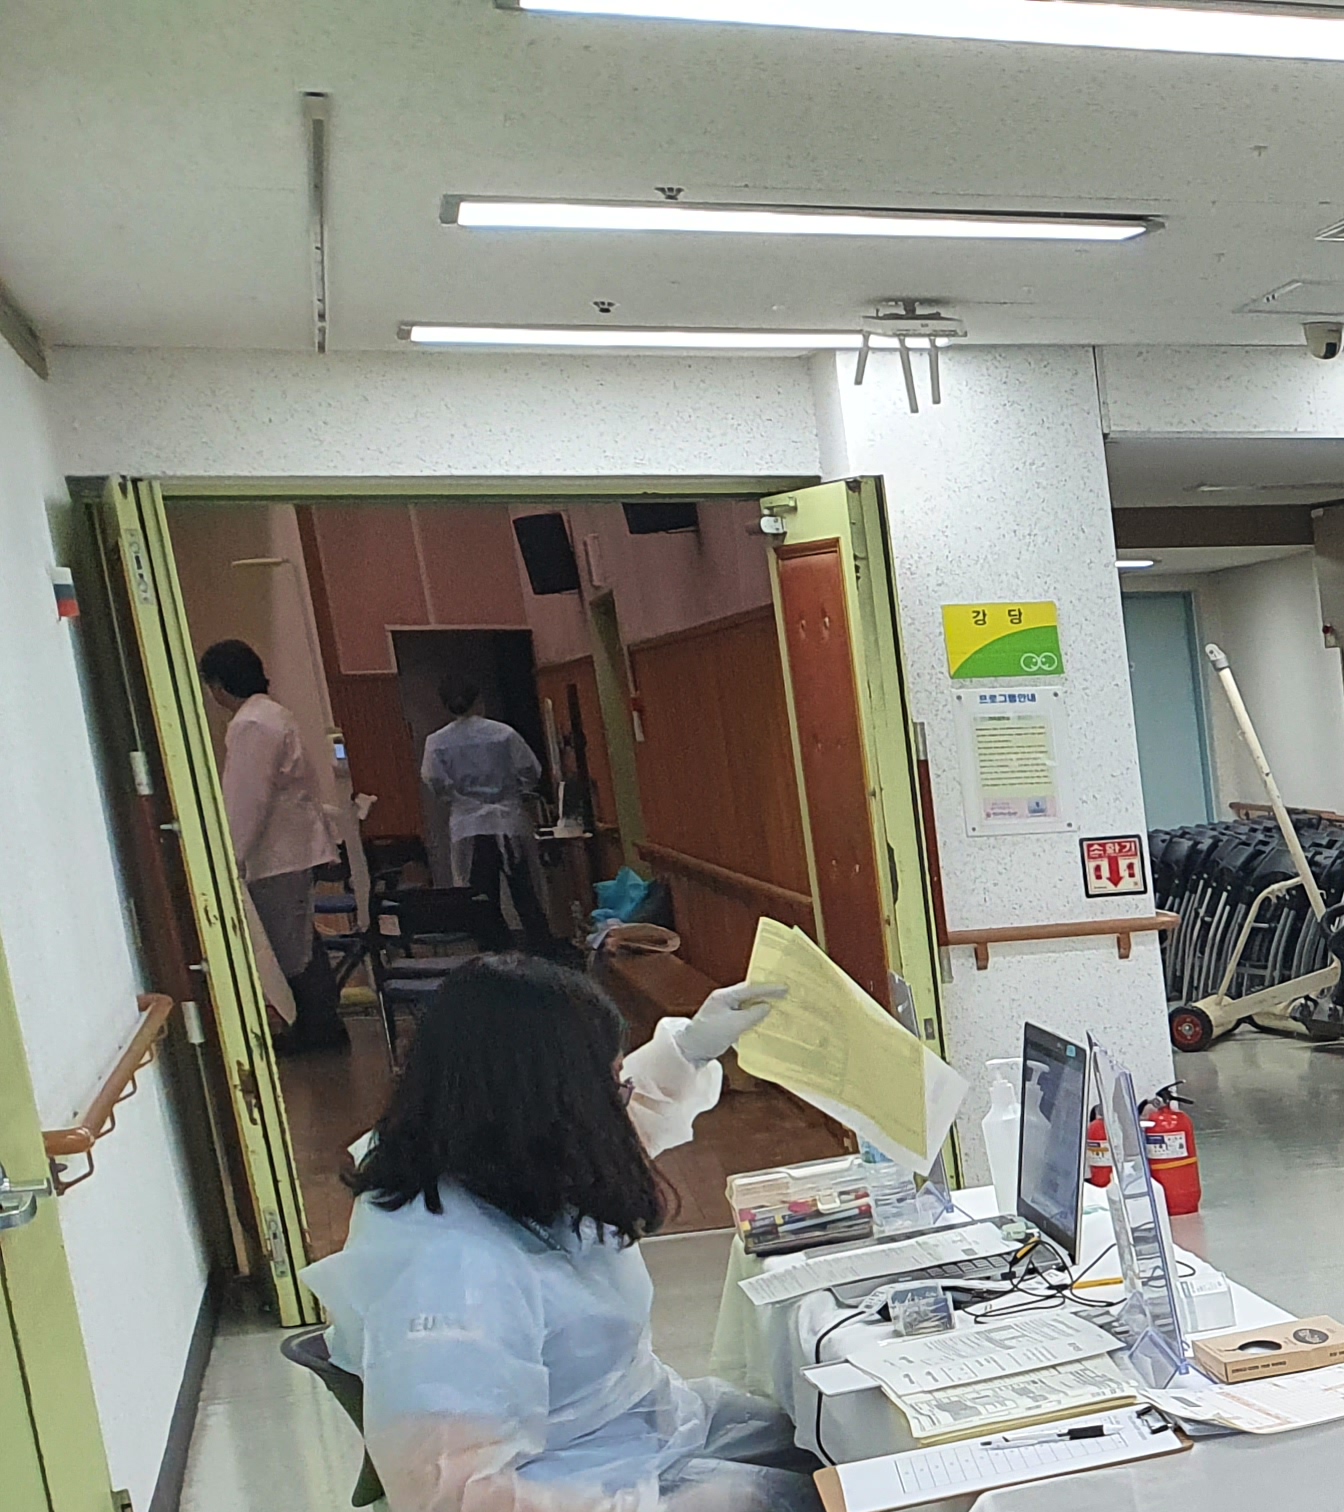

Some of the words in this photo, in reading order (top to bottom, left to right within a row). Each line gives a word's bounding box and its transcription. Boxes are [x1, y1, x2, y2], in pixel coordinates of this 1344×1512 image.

[971, 609, 988, 626] 강
[1007, 607, 1023, 625] 당
[1088, 841, 1136, 858] 소화기
